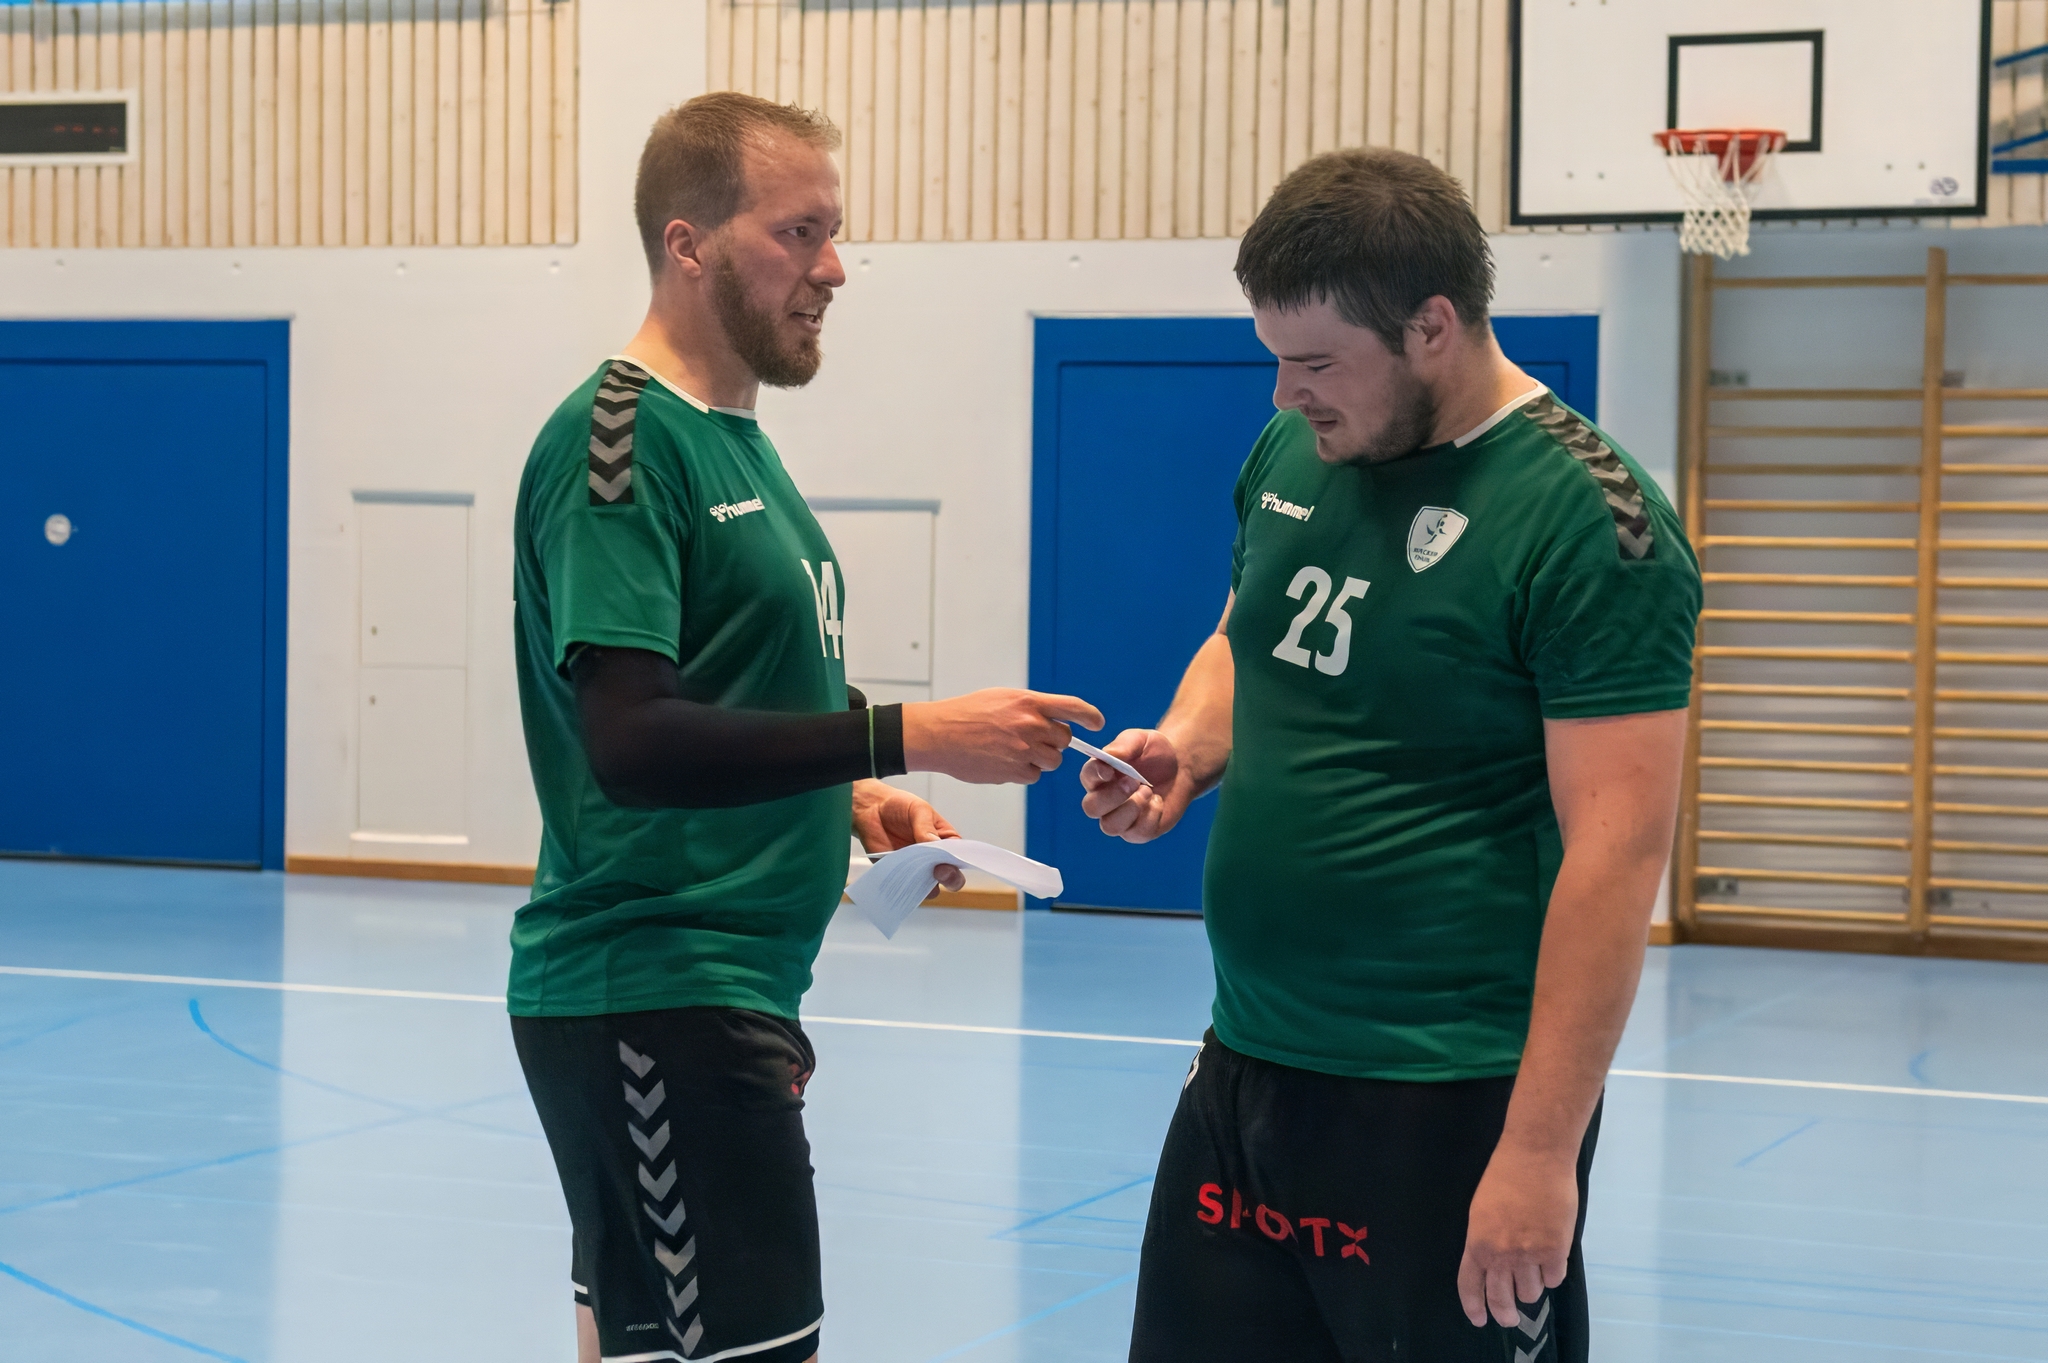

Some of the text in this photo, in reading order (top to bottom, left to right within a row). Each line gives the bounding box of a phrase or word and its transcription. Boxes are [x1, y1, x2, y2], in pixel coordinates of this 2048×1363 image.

[1268, 493, 1315, 522] hummel
[800, 558, 842, 660] 14
[1271, 565, 1371, 677] 25
[1196, 1182, 1371, 1266] SOTX
